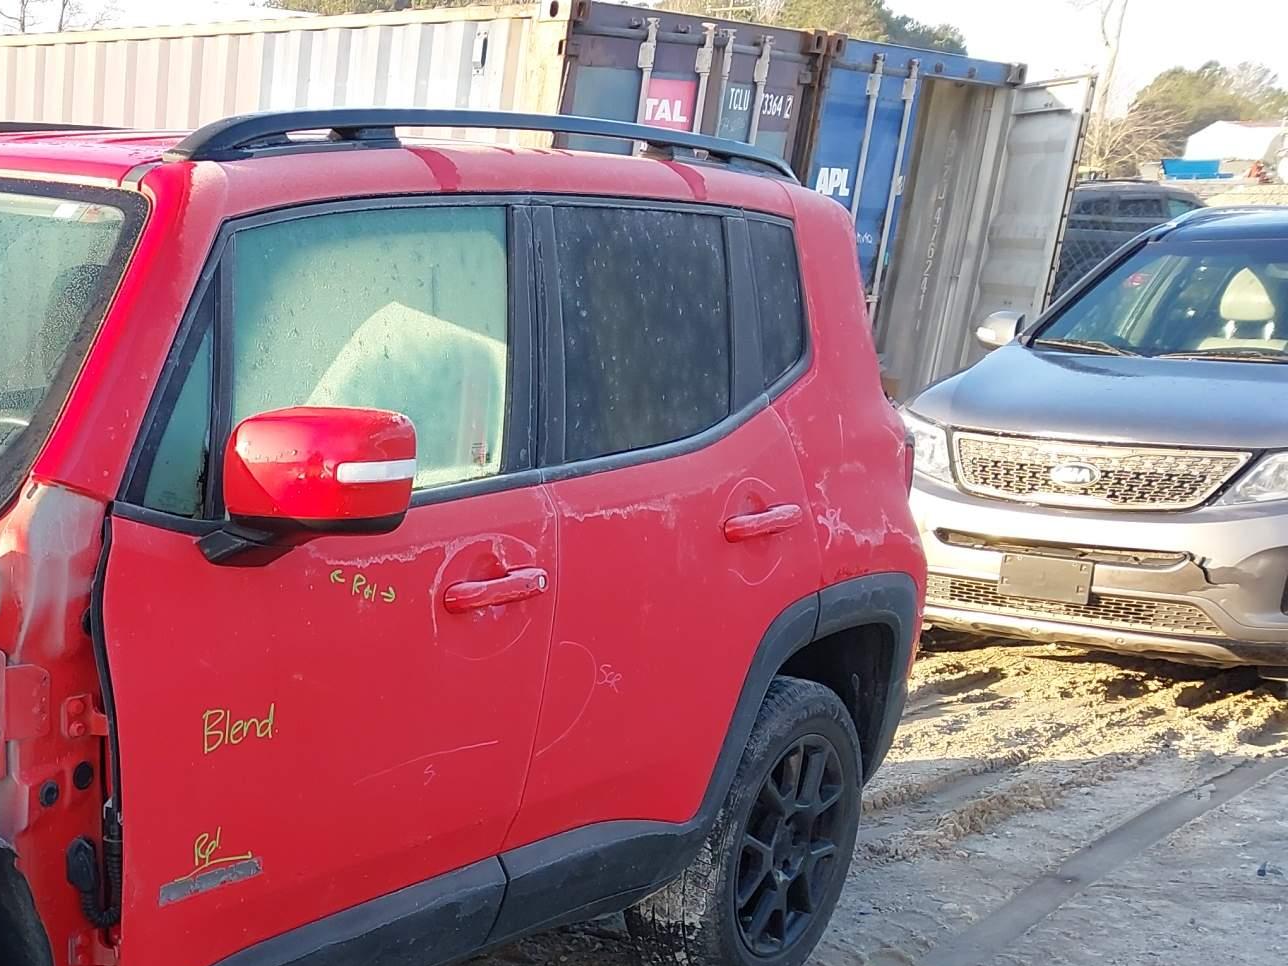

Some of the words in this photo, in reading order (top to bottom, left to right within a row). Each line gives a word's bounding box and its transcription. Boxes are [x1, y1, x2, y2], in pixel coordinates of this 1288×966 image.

[645, 98, 688, 122] TAL
[728, 87, 751, 111] TCLU
[816, 167, 850, 196] APL
